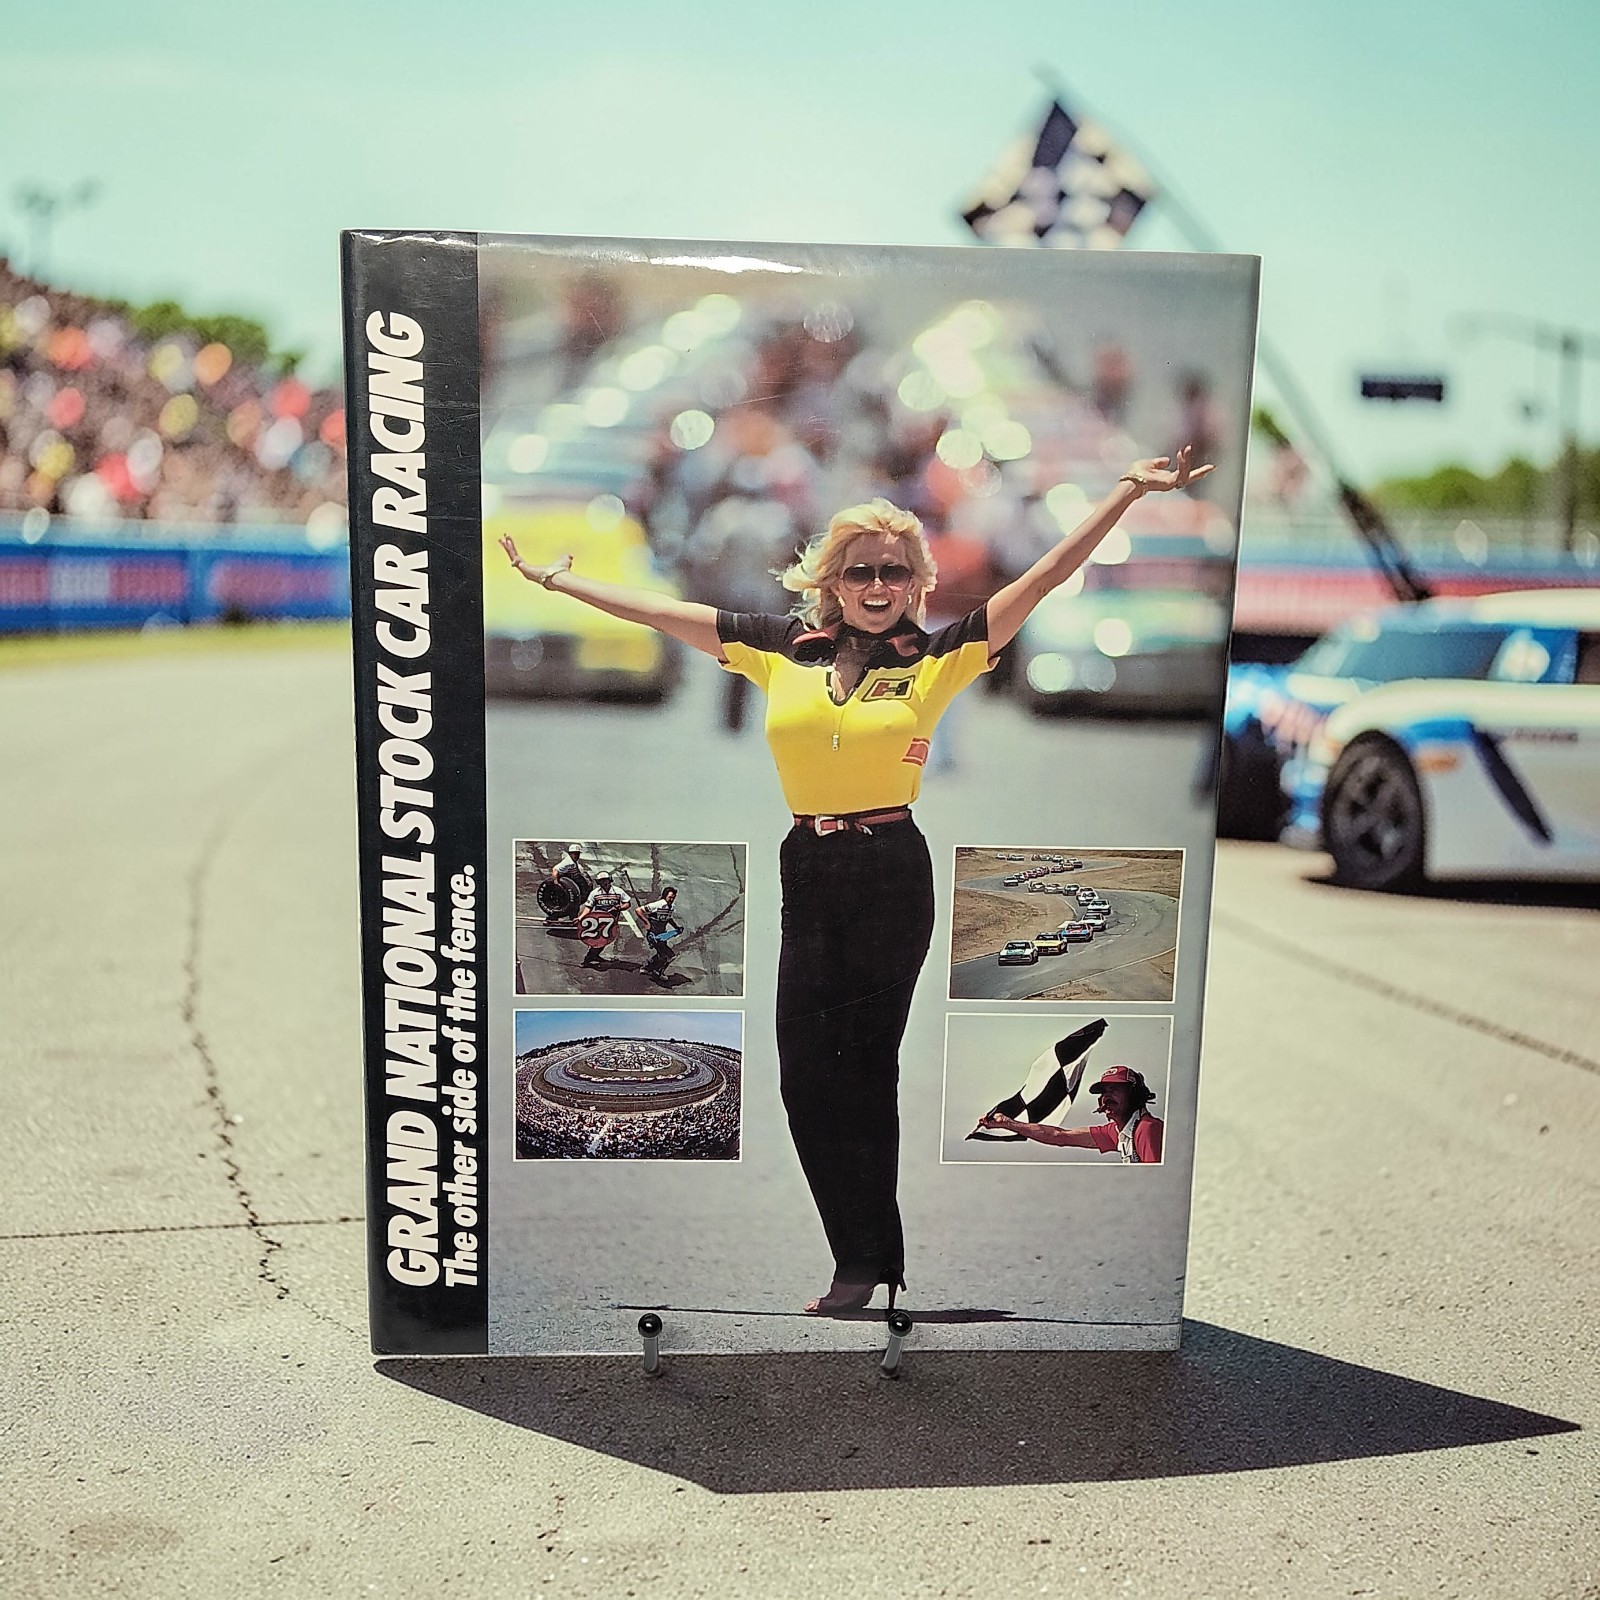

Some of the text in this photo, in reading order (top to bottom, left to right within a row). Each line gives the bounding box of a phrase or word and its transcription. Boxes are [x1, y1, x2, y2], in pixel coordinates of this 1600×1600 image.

[366, 310, 440, 1287] GRAND NATIONAL STOCK CAR RACING
[580, 917, 615, 938] 27
[440, 864, 478, 1288] The other side of the fence.
